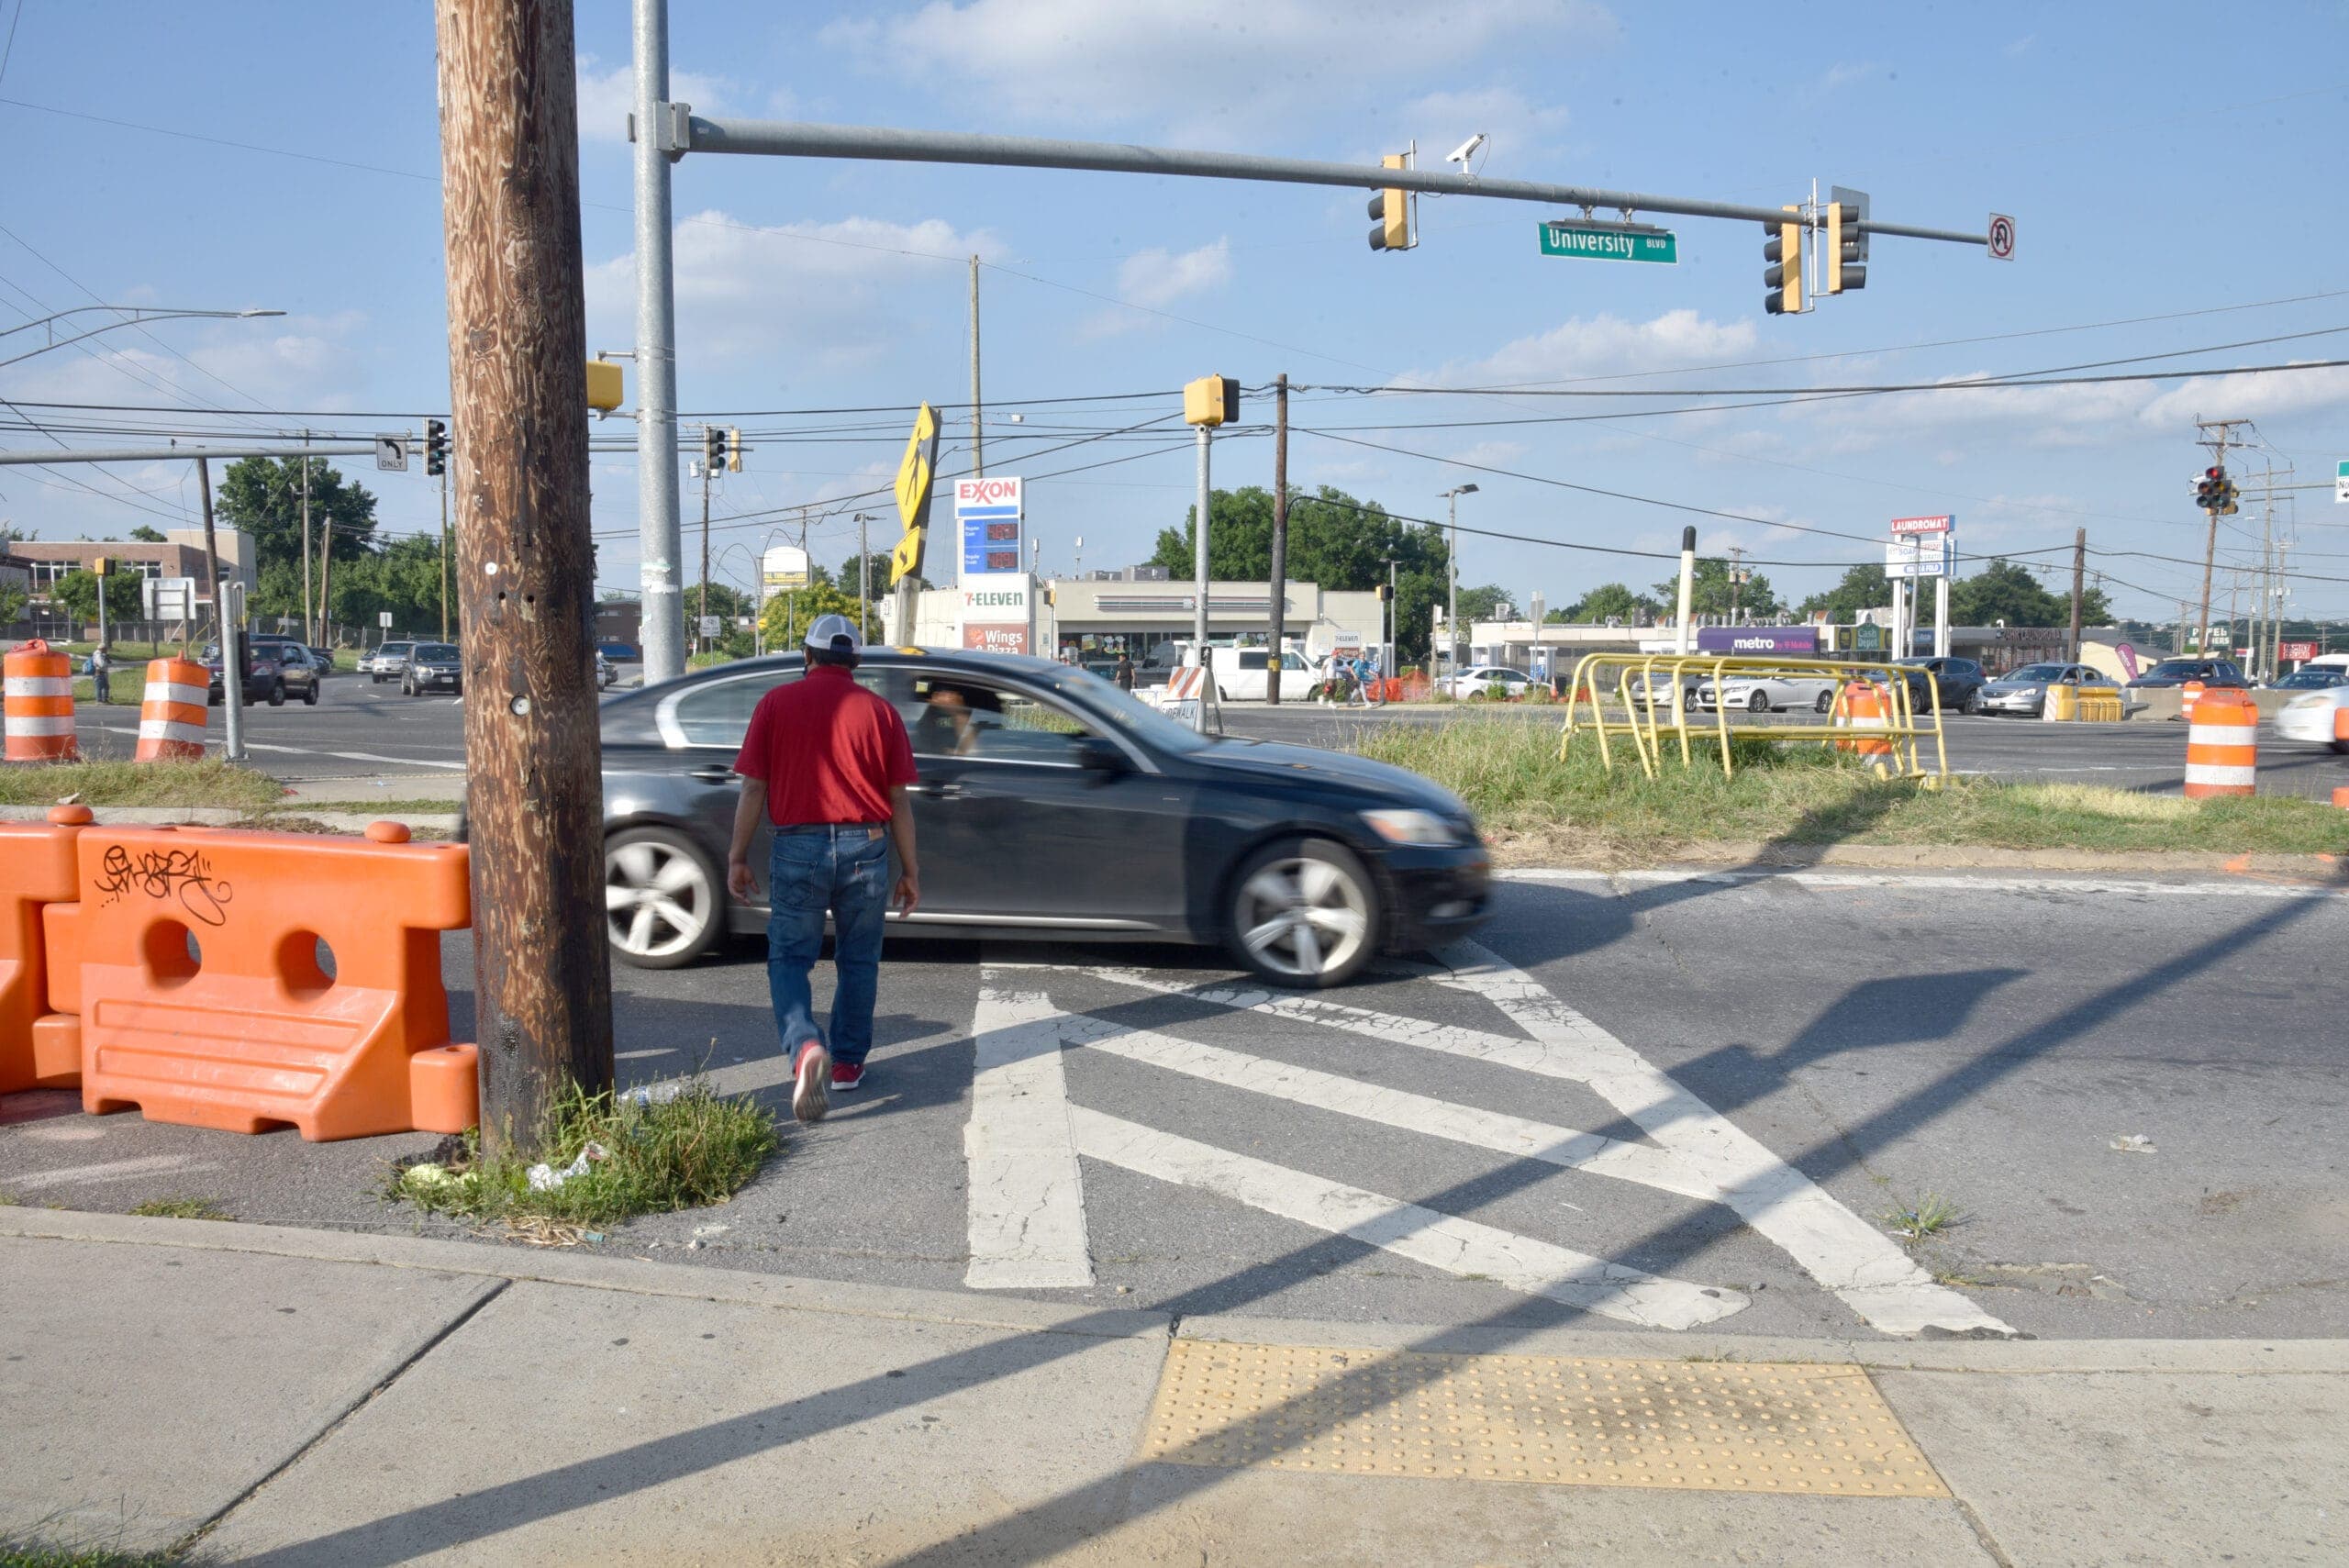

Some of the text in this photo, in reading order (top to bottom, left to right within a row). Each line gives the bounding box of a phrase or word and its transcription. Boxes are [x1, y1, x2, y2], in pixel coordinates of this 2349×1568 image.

[1549, 228, 1666, 258] University BLVD
[381, 460, 403, 468] ONLY
[959, 480, 1016, 504] EXXON
[1891, 517, 1947, 531] LAUNDROMAT
[985, 630, 1023, 646] Wings
[1858, 629, 1876, 638] Cash
[1733, 636, 1775, 650] metro
[1857, 638, 1878, 649] Depot
